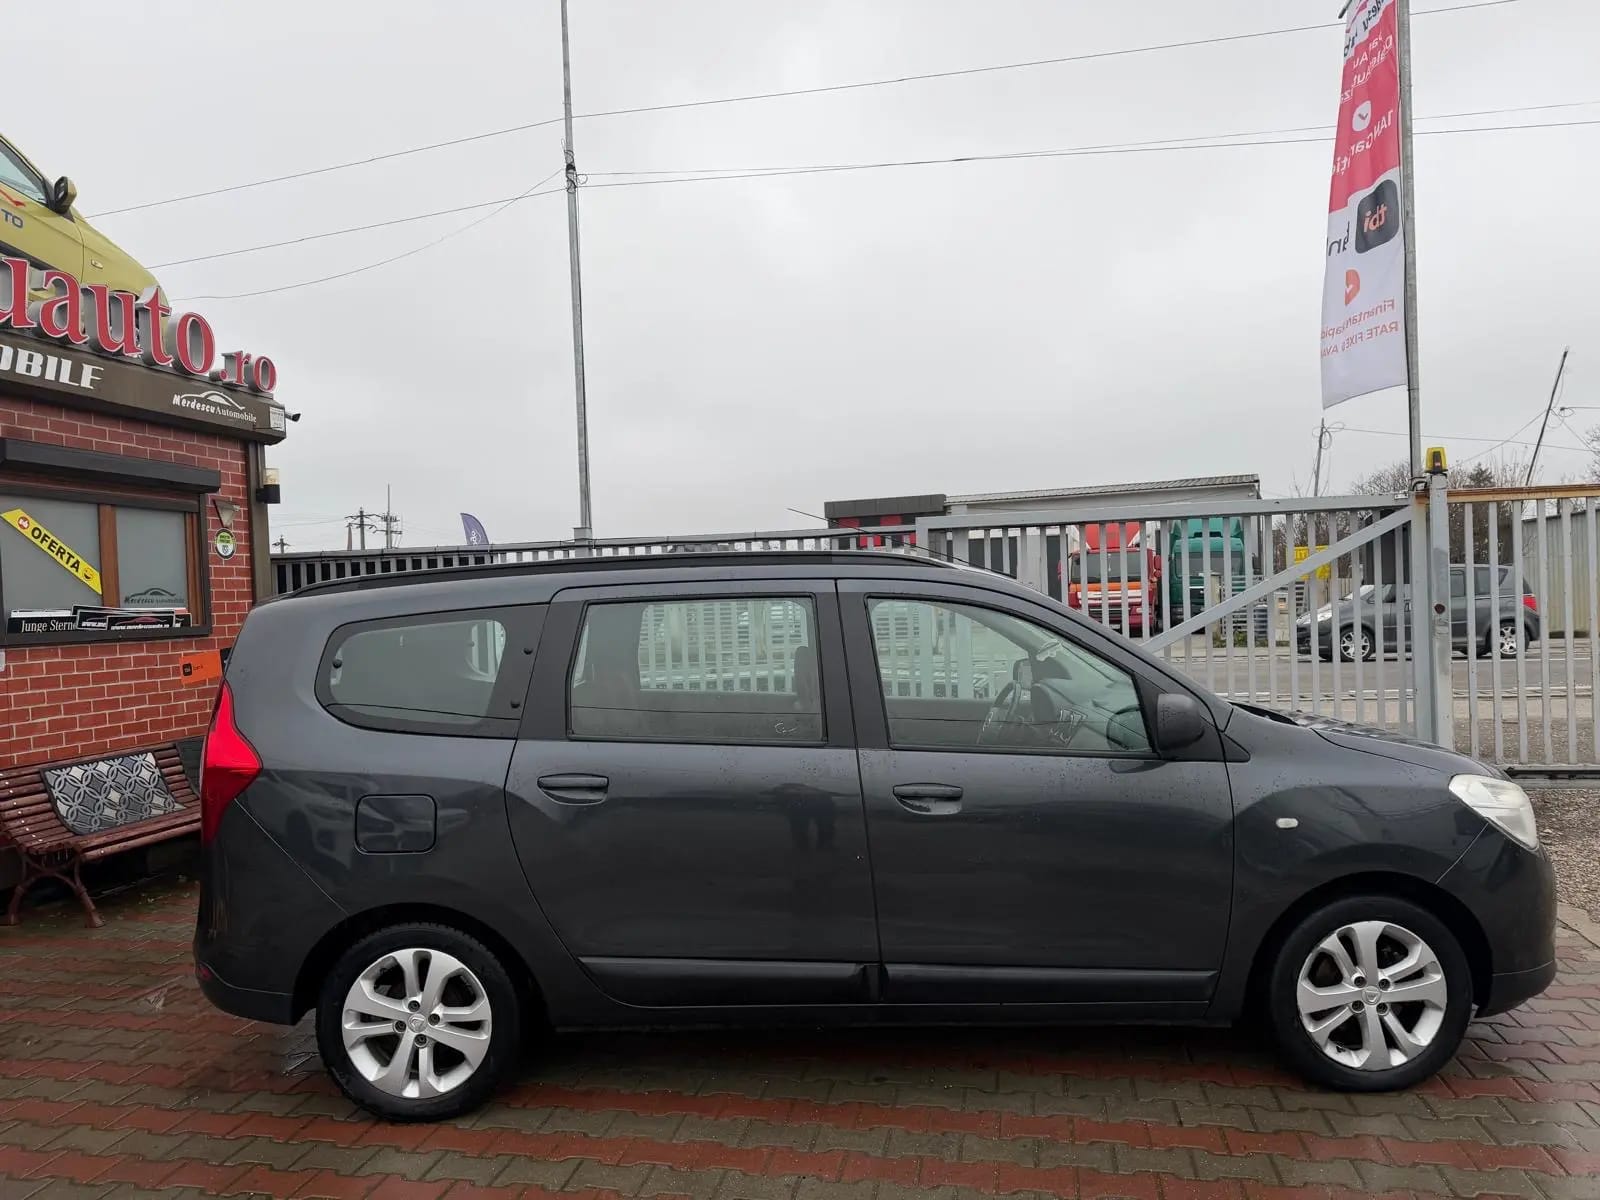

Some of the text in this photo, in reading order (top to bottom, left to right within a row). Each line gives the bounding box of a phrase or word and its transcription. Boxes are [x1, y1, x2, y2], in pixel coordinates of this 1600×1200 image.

[172, 393, 215, 414] Merdescu
[215, 406, 257, 423] Automobile
[31, 526, 81, 573] OFERTA
[21, 619, 48, 633] Junge
